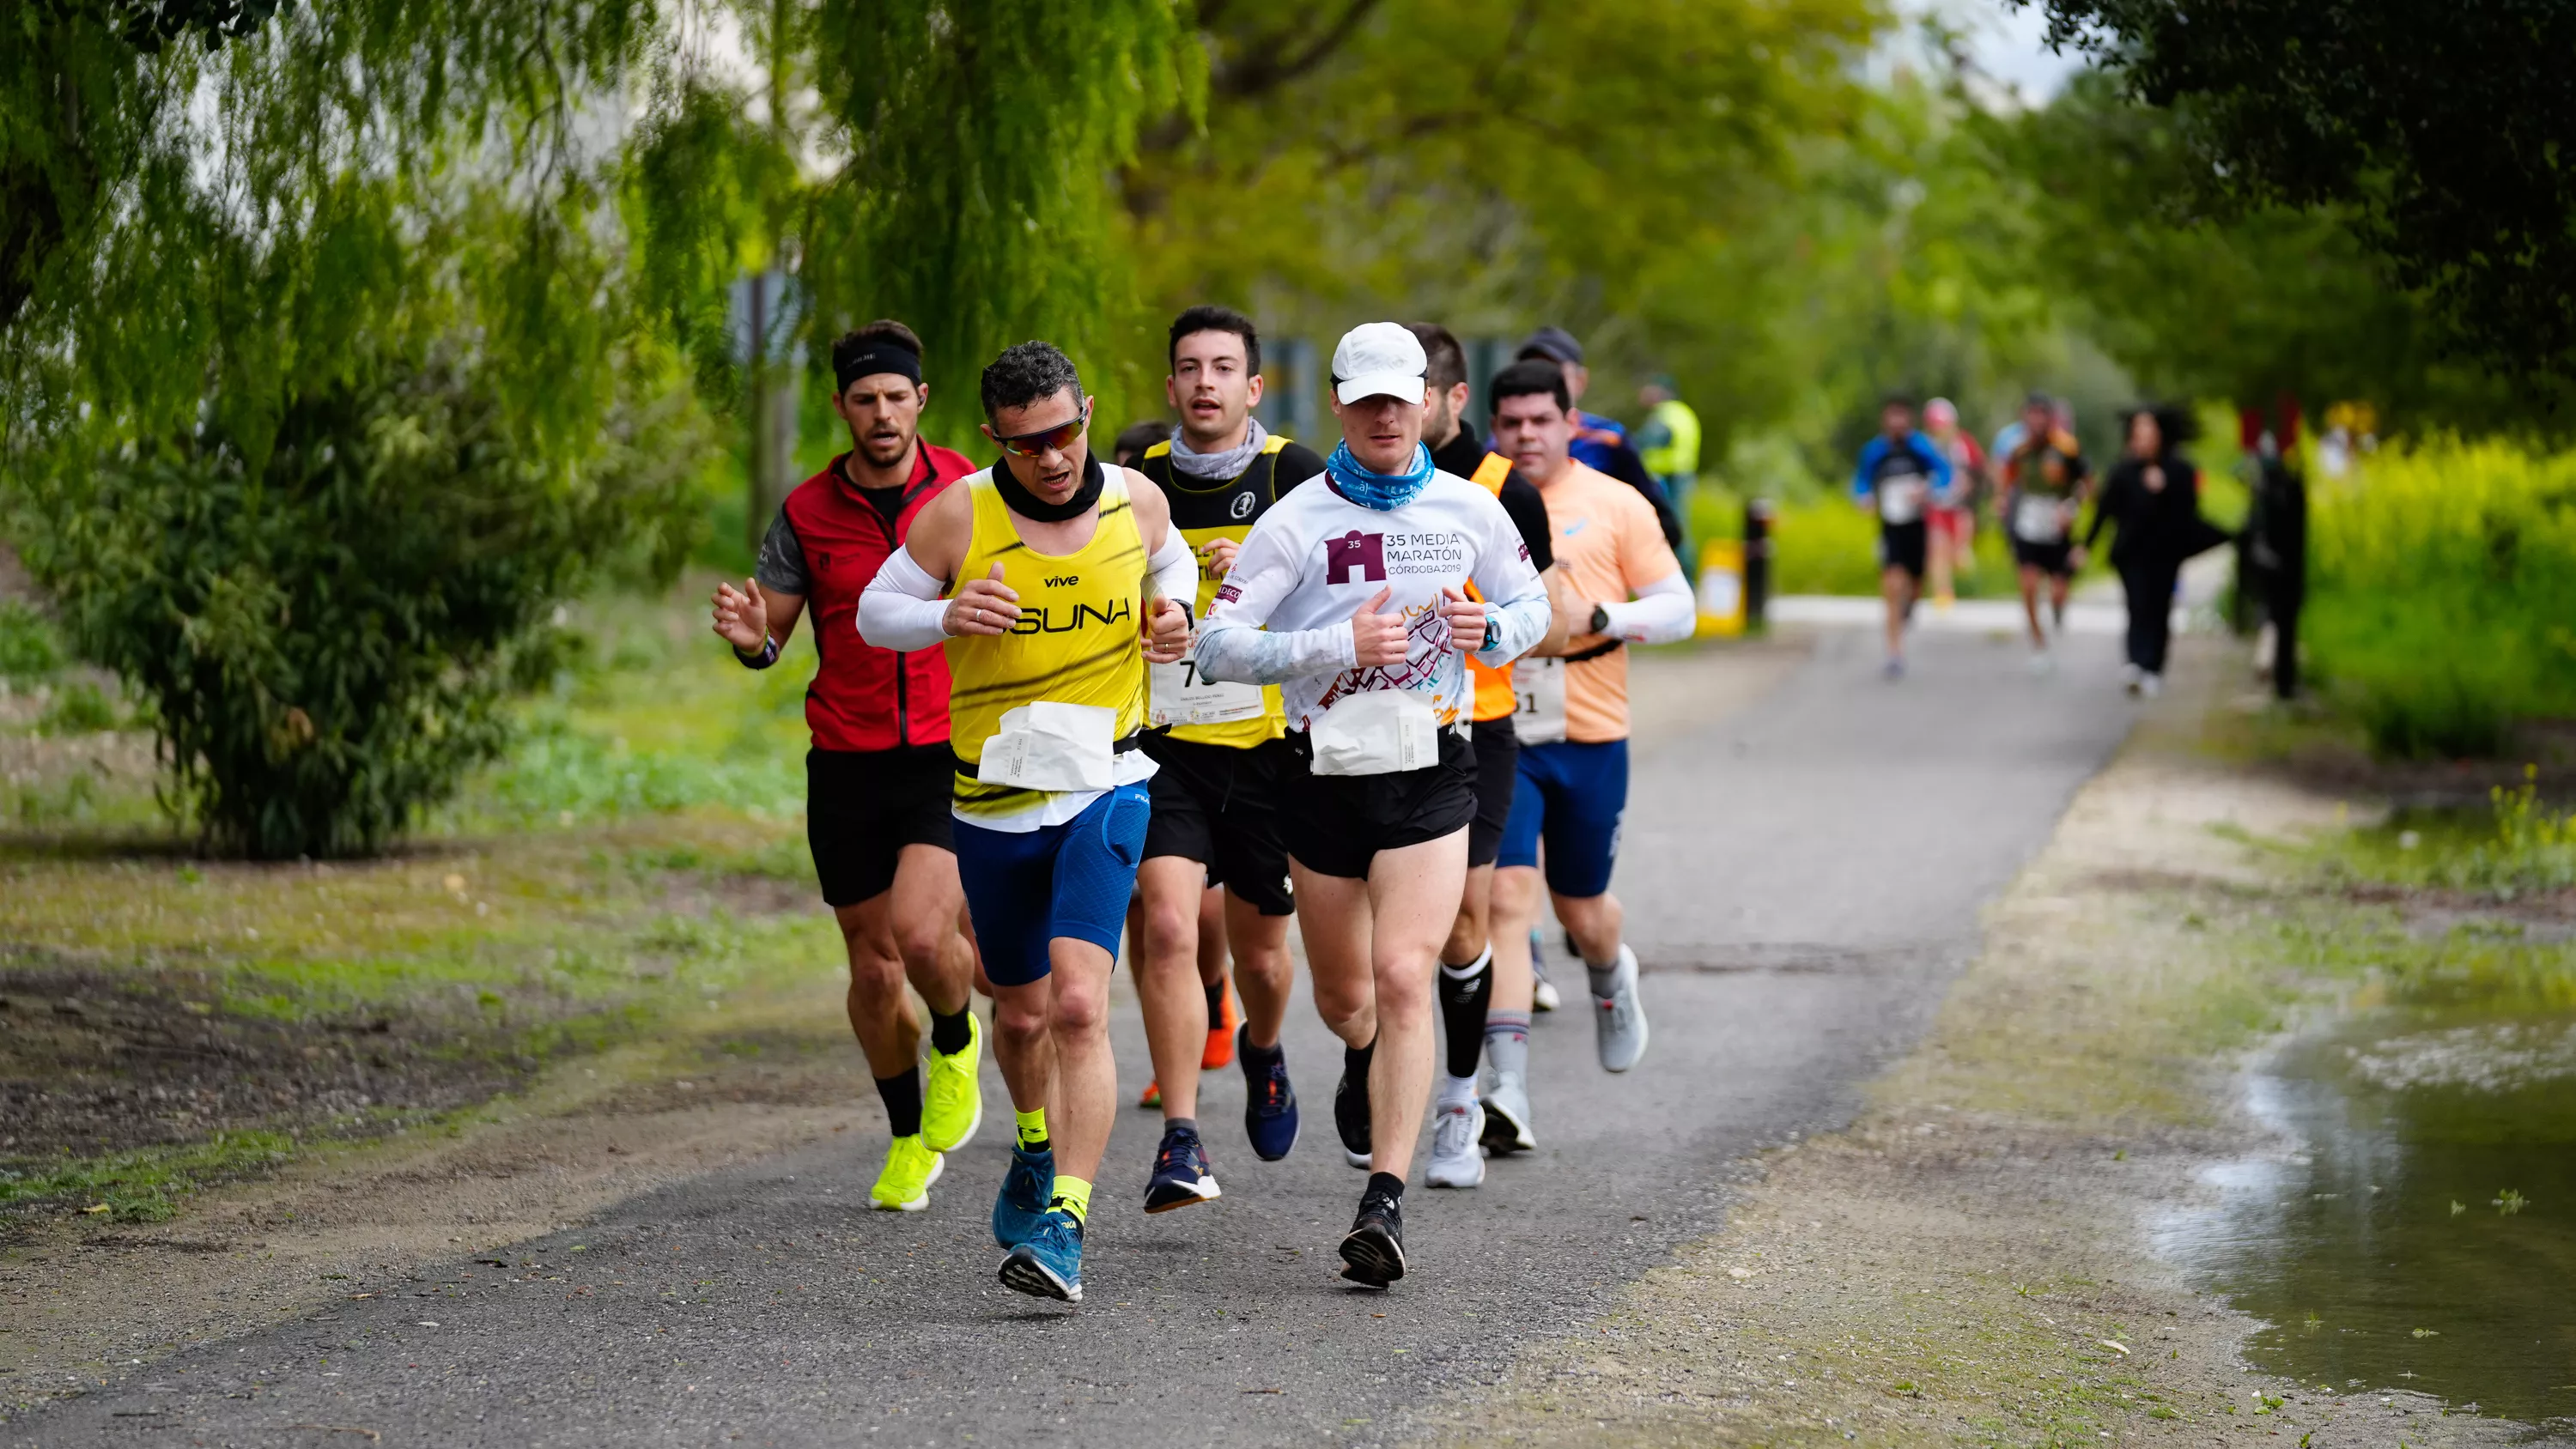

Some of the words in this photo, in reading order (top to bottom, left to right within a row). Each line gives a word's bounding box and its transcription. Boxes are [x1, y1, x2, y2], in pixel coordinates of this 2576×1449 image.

[1347, 540, 1362, 549] 35
[1386, 534, 1406, 547] 35
[1411, 533, 1461, 546] MEDIA
[1387, 546, 1461, 562] MARATÓN
[1388, 564, 1441, 574] CÓRDOBA
[1442, 563, 1461, 573] 2019
[1044, 575, 1079, 588] vive
[1002, 597, 1131, 635] SUNA
[1180, 659, 1218, 688] 7
